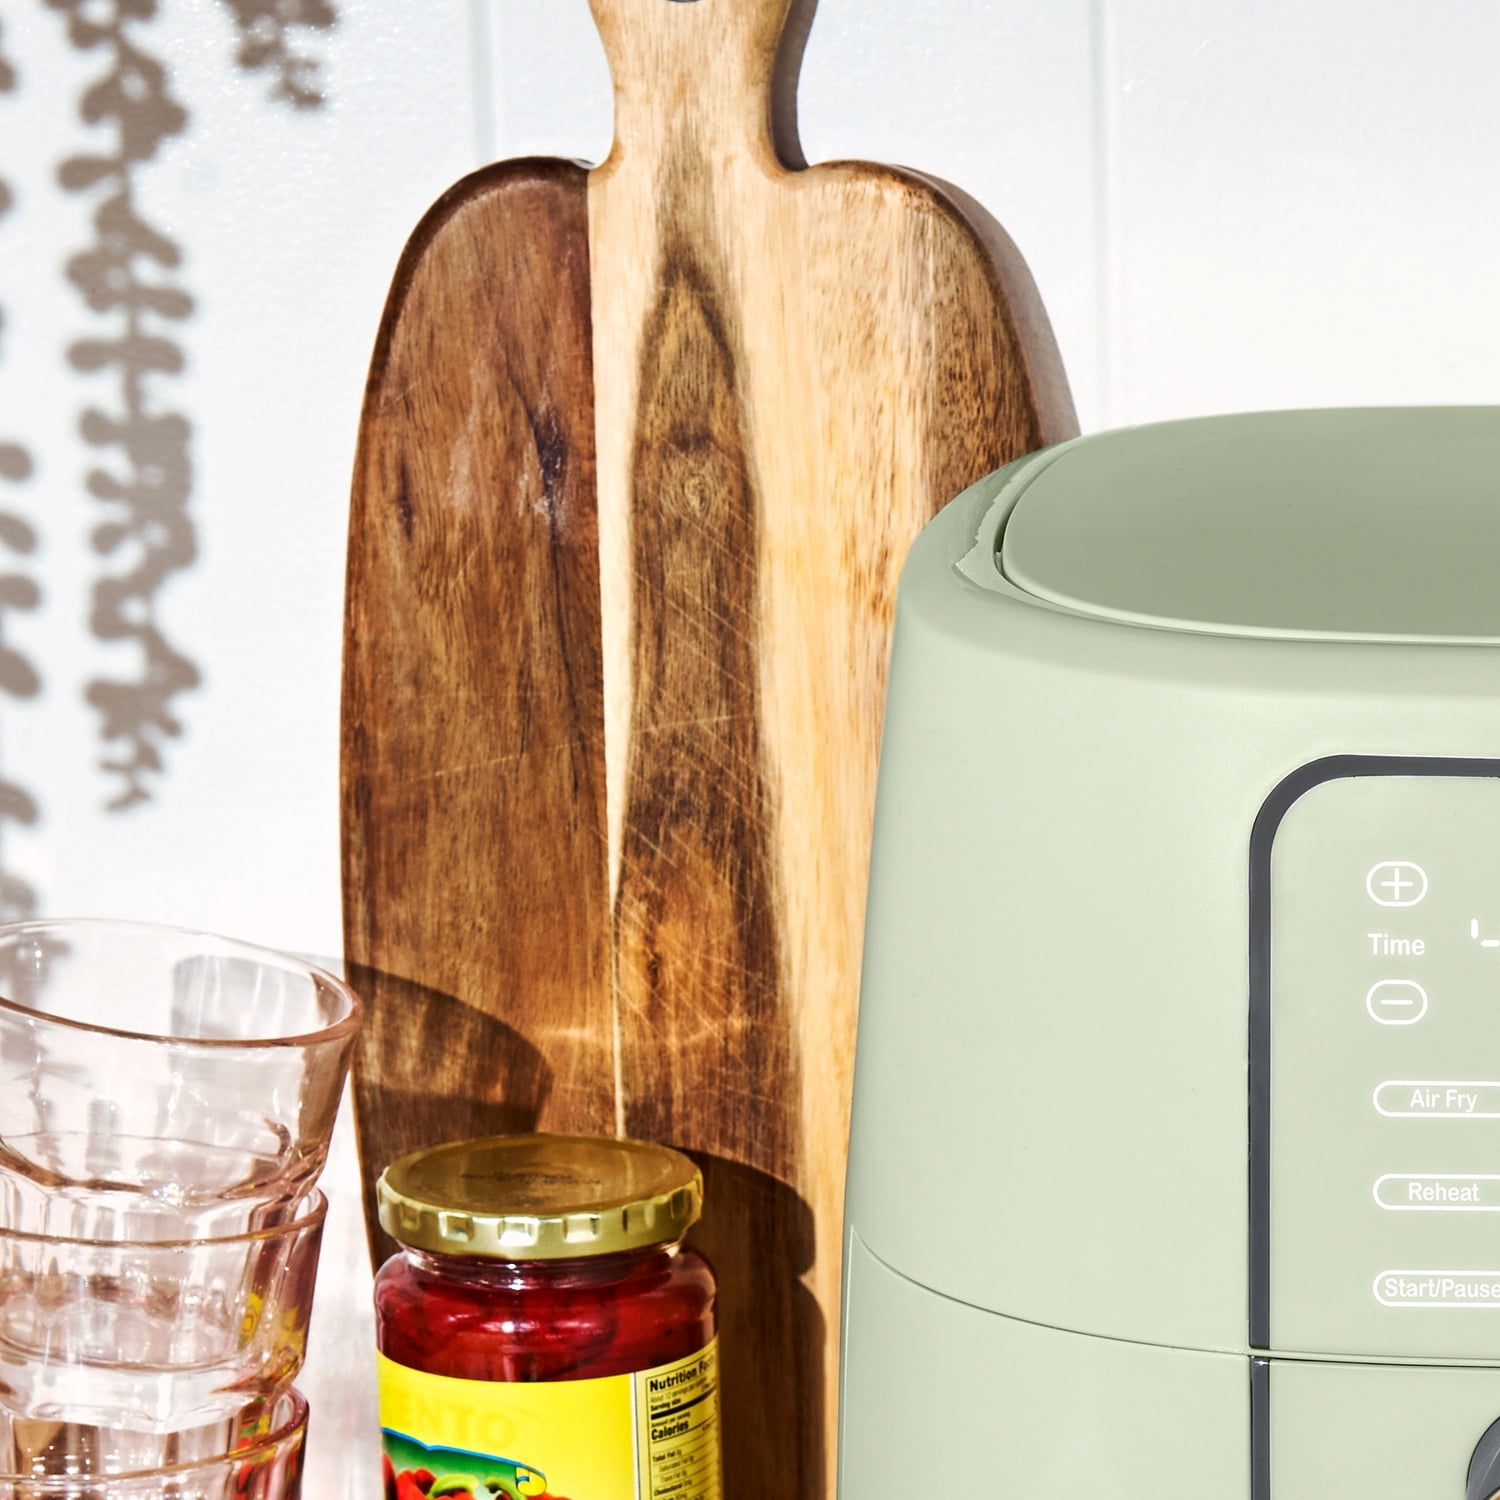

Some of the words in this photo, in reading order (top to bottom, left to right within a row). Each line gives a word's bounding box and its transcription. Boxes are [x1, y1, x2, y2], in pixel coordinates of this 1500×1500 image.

[1367, 933, 1425, 956] Time
[1410, 1088, 1440, 1109] Air
[1445, 1089, 1477, 1114] Fry
[1408, 1182, 1480, 1204] Reheat
[650, 1367, 697, 1392] Nutrition
[652, 1421, 689, 1441] Calories
